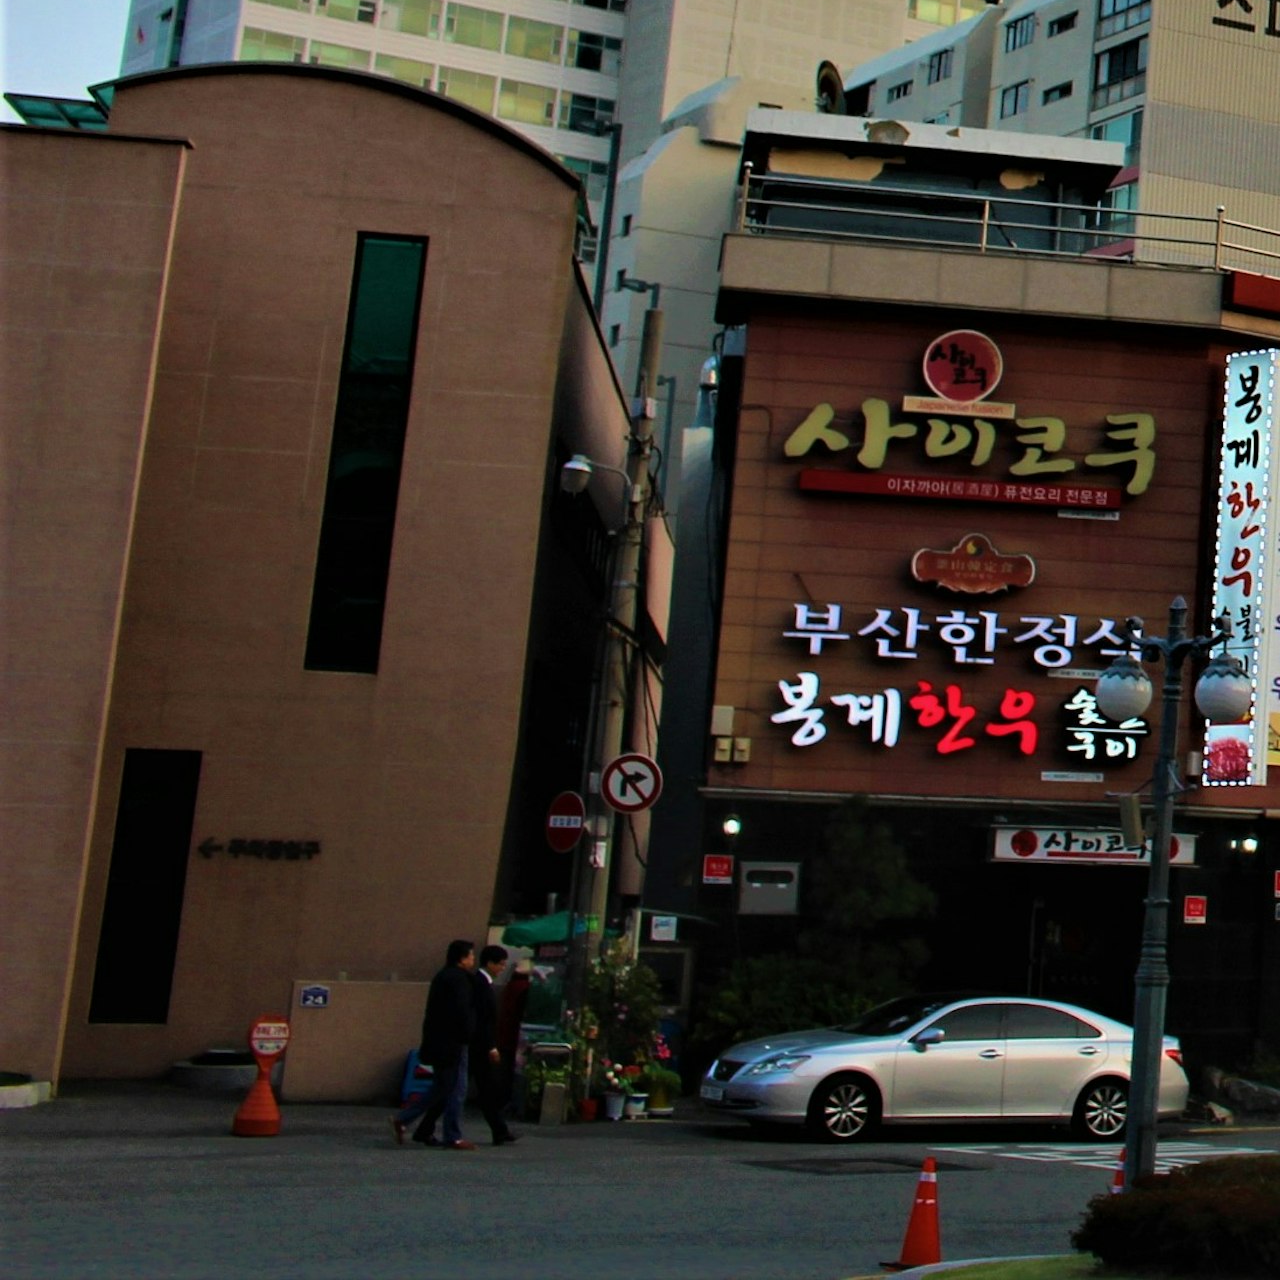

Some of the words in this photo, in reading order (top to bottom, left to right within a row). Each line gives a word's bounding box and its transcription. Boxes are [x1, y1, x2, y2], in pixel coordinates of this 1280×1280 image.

[784, 397, 1156, 496] 사이코쿠
[1065, 490, 1108, 507] 전문점
[782, 603, 1145, 668] 부산한정식
[1065, 732, 1137, 760] 구이
[305, 995, 323, 1005] 24
